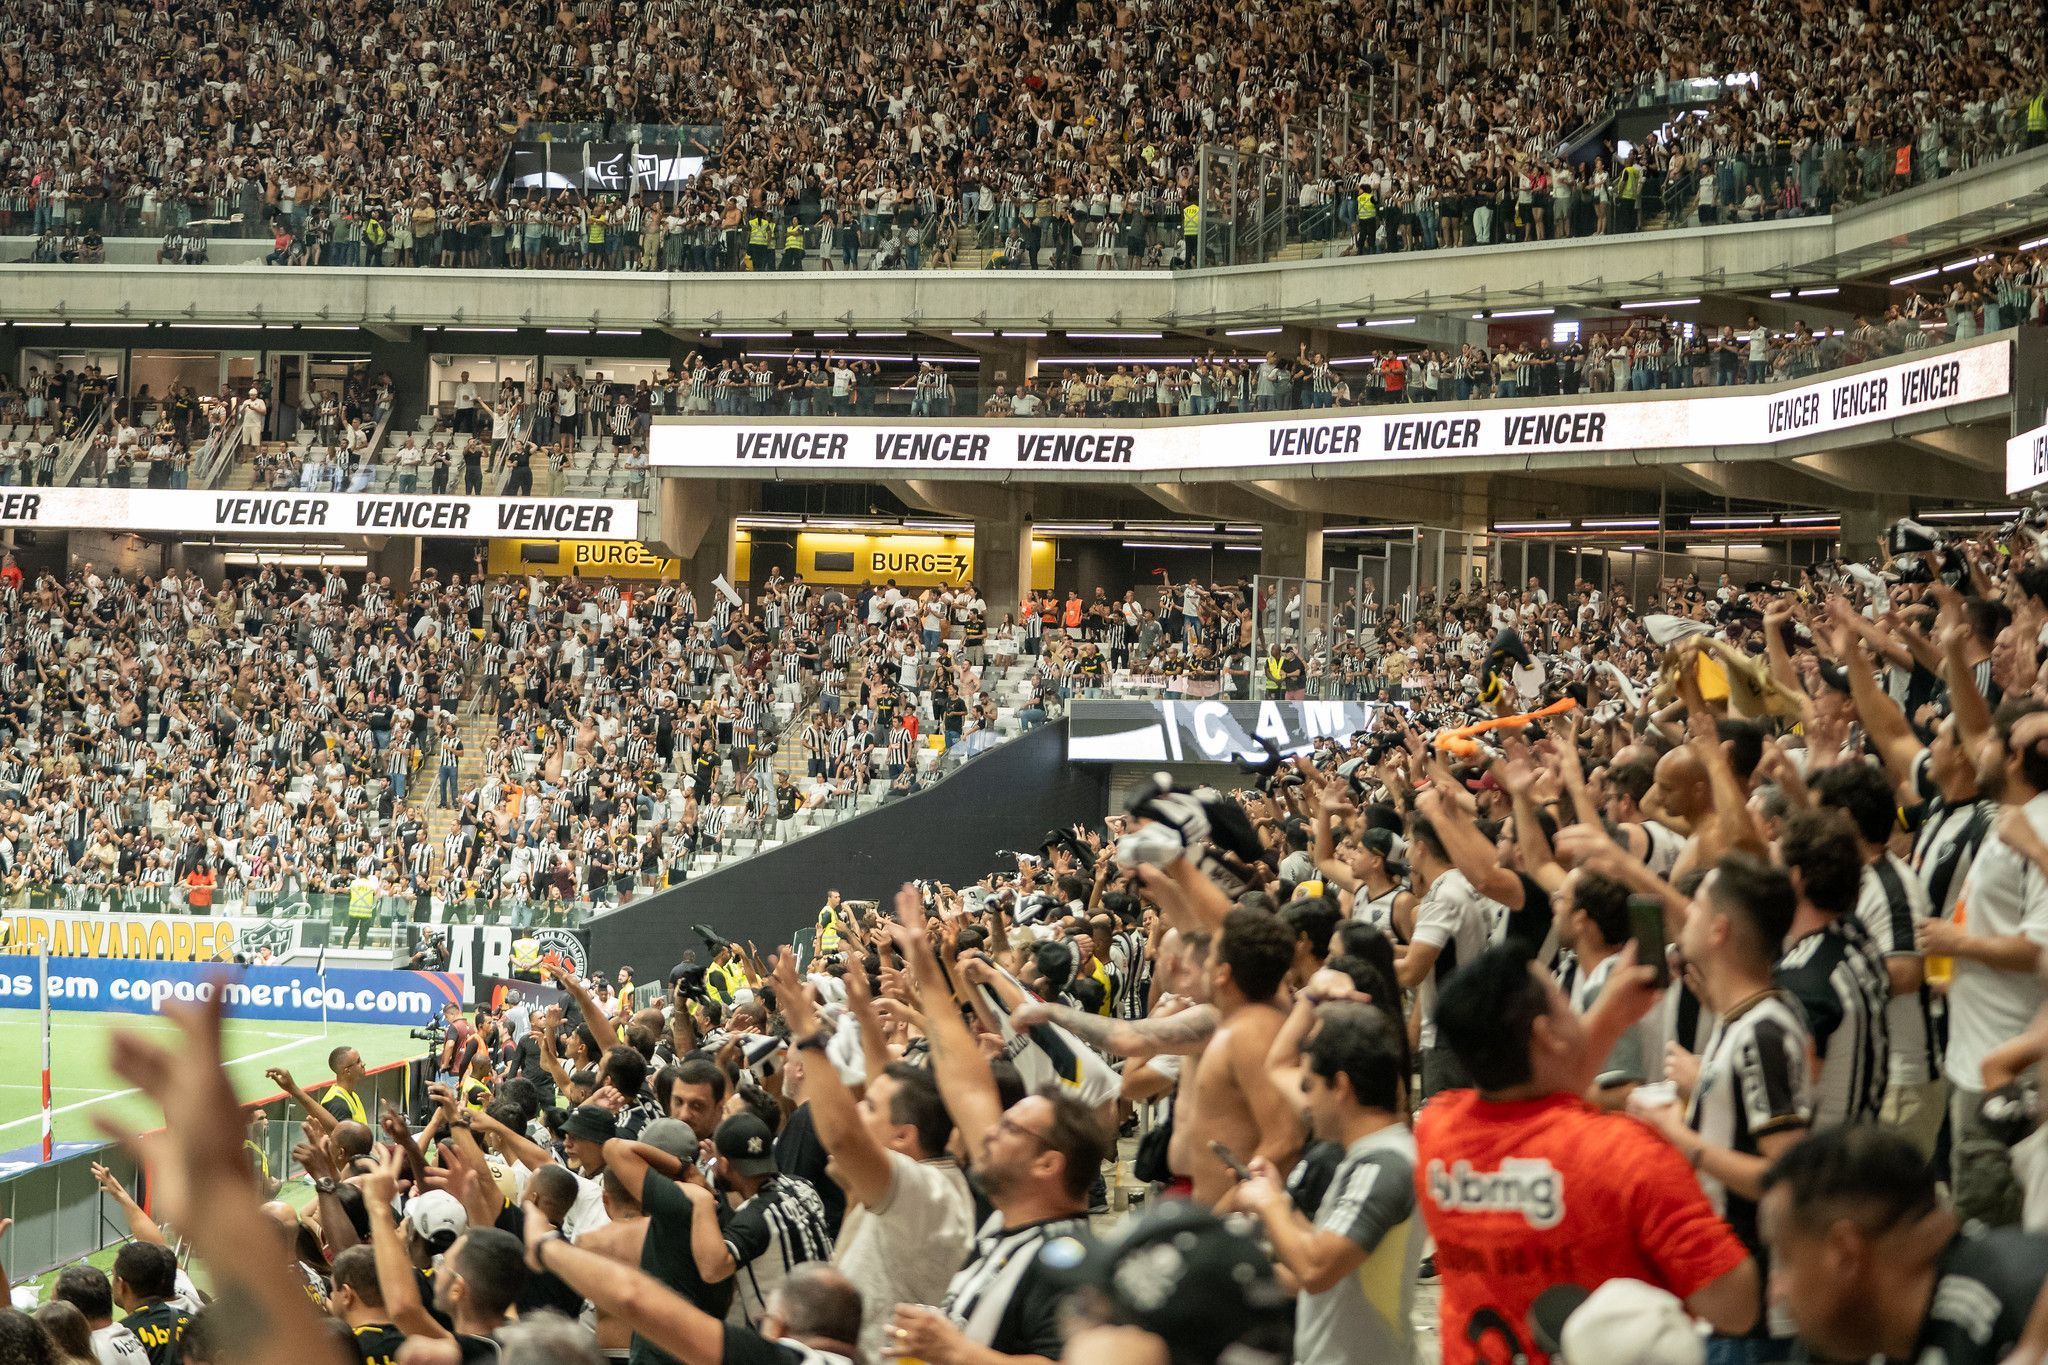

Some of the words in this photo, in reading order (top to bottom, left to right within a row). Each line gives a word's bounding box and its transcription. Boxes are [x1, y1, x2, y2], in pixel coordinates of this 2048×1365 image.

[1767, 392, 1820, 434] VENCER
[1832, 377, 1889, 421] VENCER
[1901, 360, 1961, 406] VENCER
[736, 432, 848, 460] VENCER
[875, 434, 990, 462] VENCER
[1018, 435, 1134, 463] VENCER
[1269, 424, 1361, 456] VENCER
[1384, 418, 1481, 451] VENCER
[1504, 412, 1607, 446] VENCER
[0, 493, 41, 519] ER
[215, 499, 329, 526] VENCER
[356, 501, 470, 530] VENCER
[498, 503, 613, 533] VENCER
[47, 975, 99, 999] em
